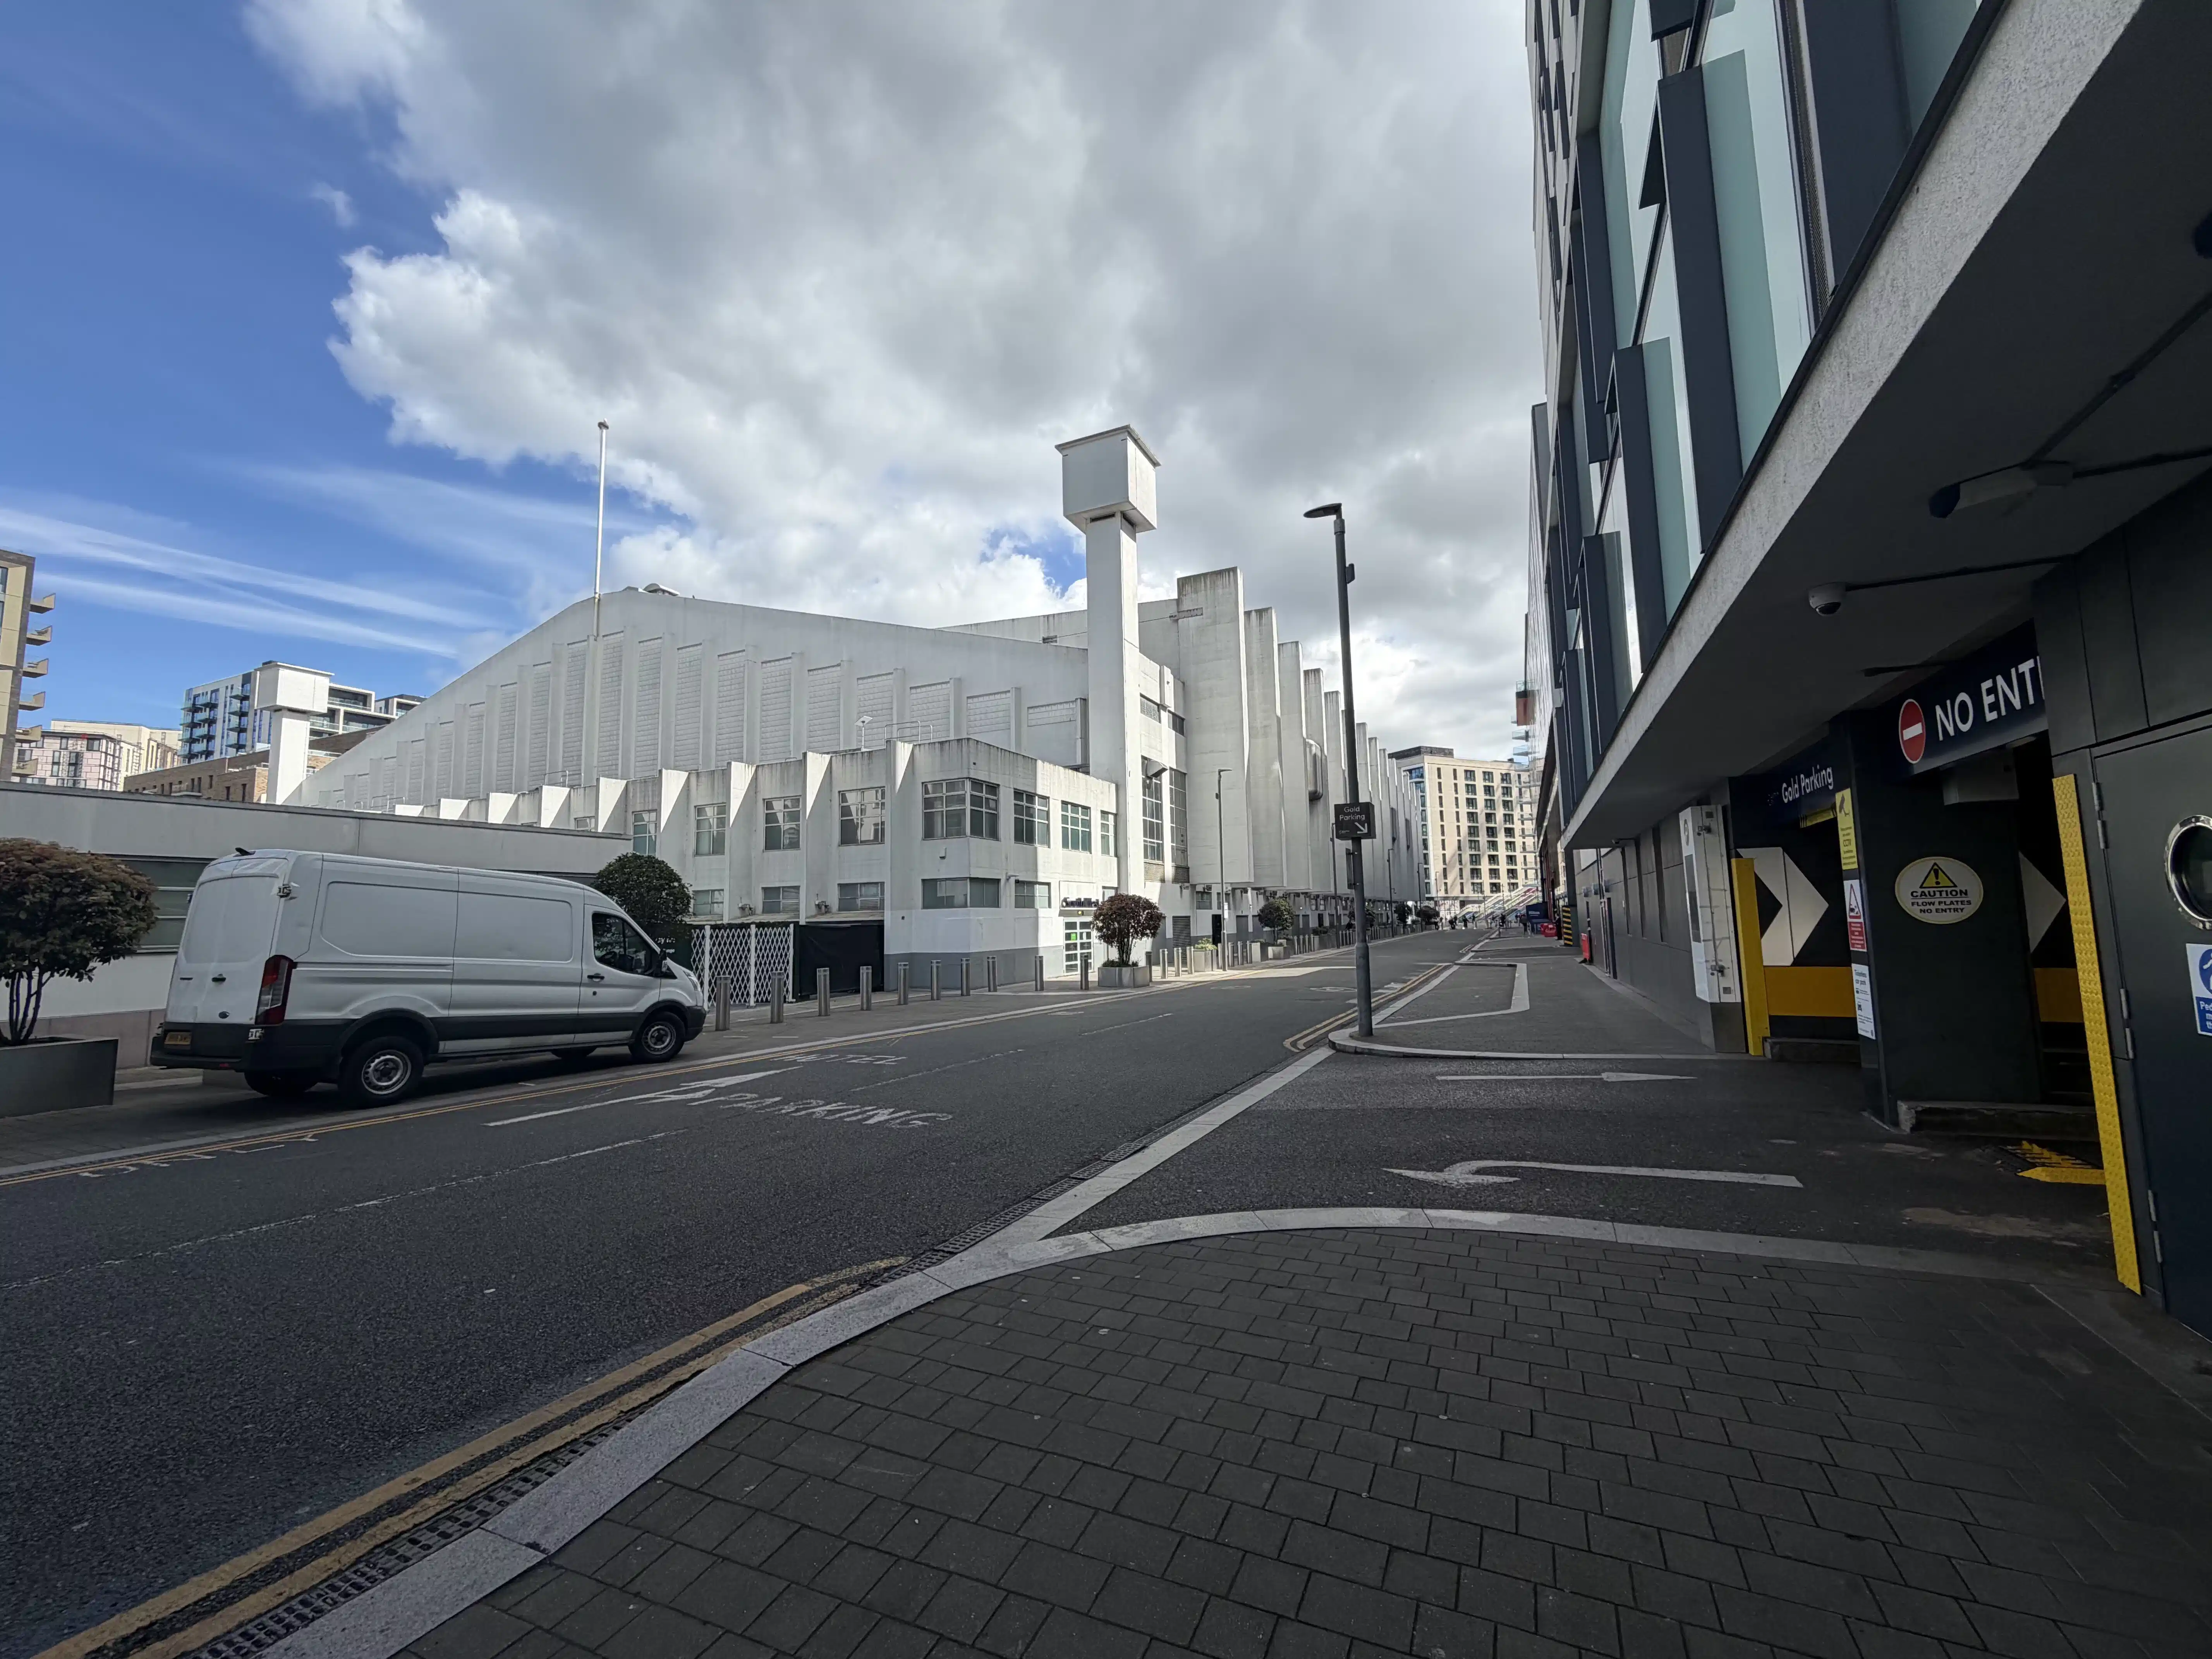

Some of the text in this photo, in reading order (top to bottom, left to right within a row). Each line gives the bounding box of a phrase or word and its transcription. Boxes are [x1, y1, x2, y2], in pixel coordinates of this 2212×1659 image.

[1935, 656, 2045, 741] NO ENT
[1782, 775, 1800, 804] Gold
[1800, 764, 1834, 795] Parking
[1910, 889, 1968, 898] CAUTION
[770, 1054, 908, 1065] HOTEL
[687, 1092, 953, 1129] PARKING
